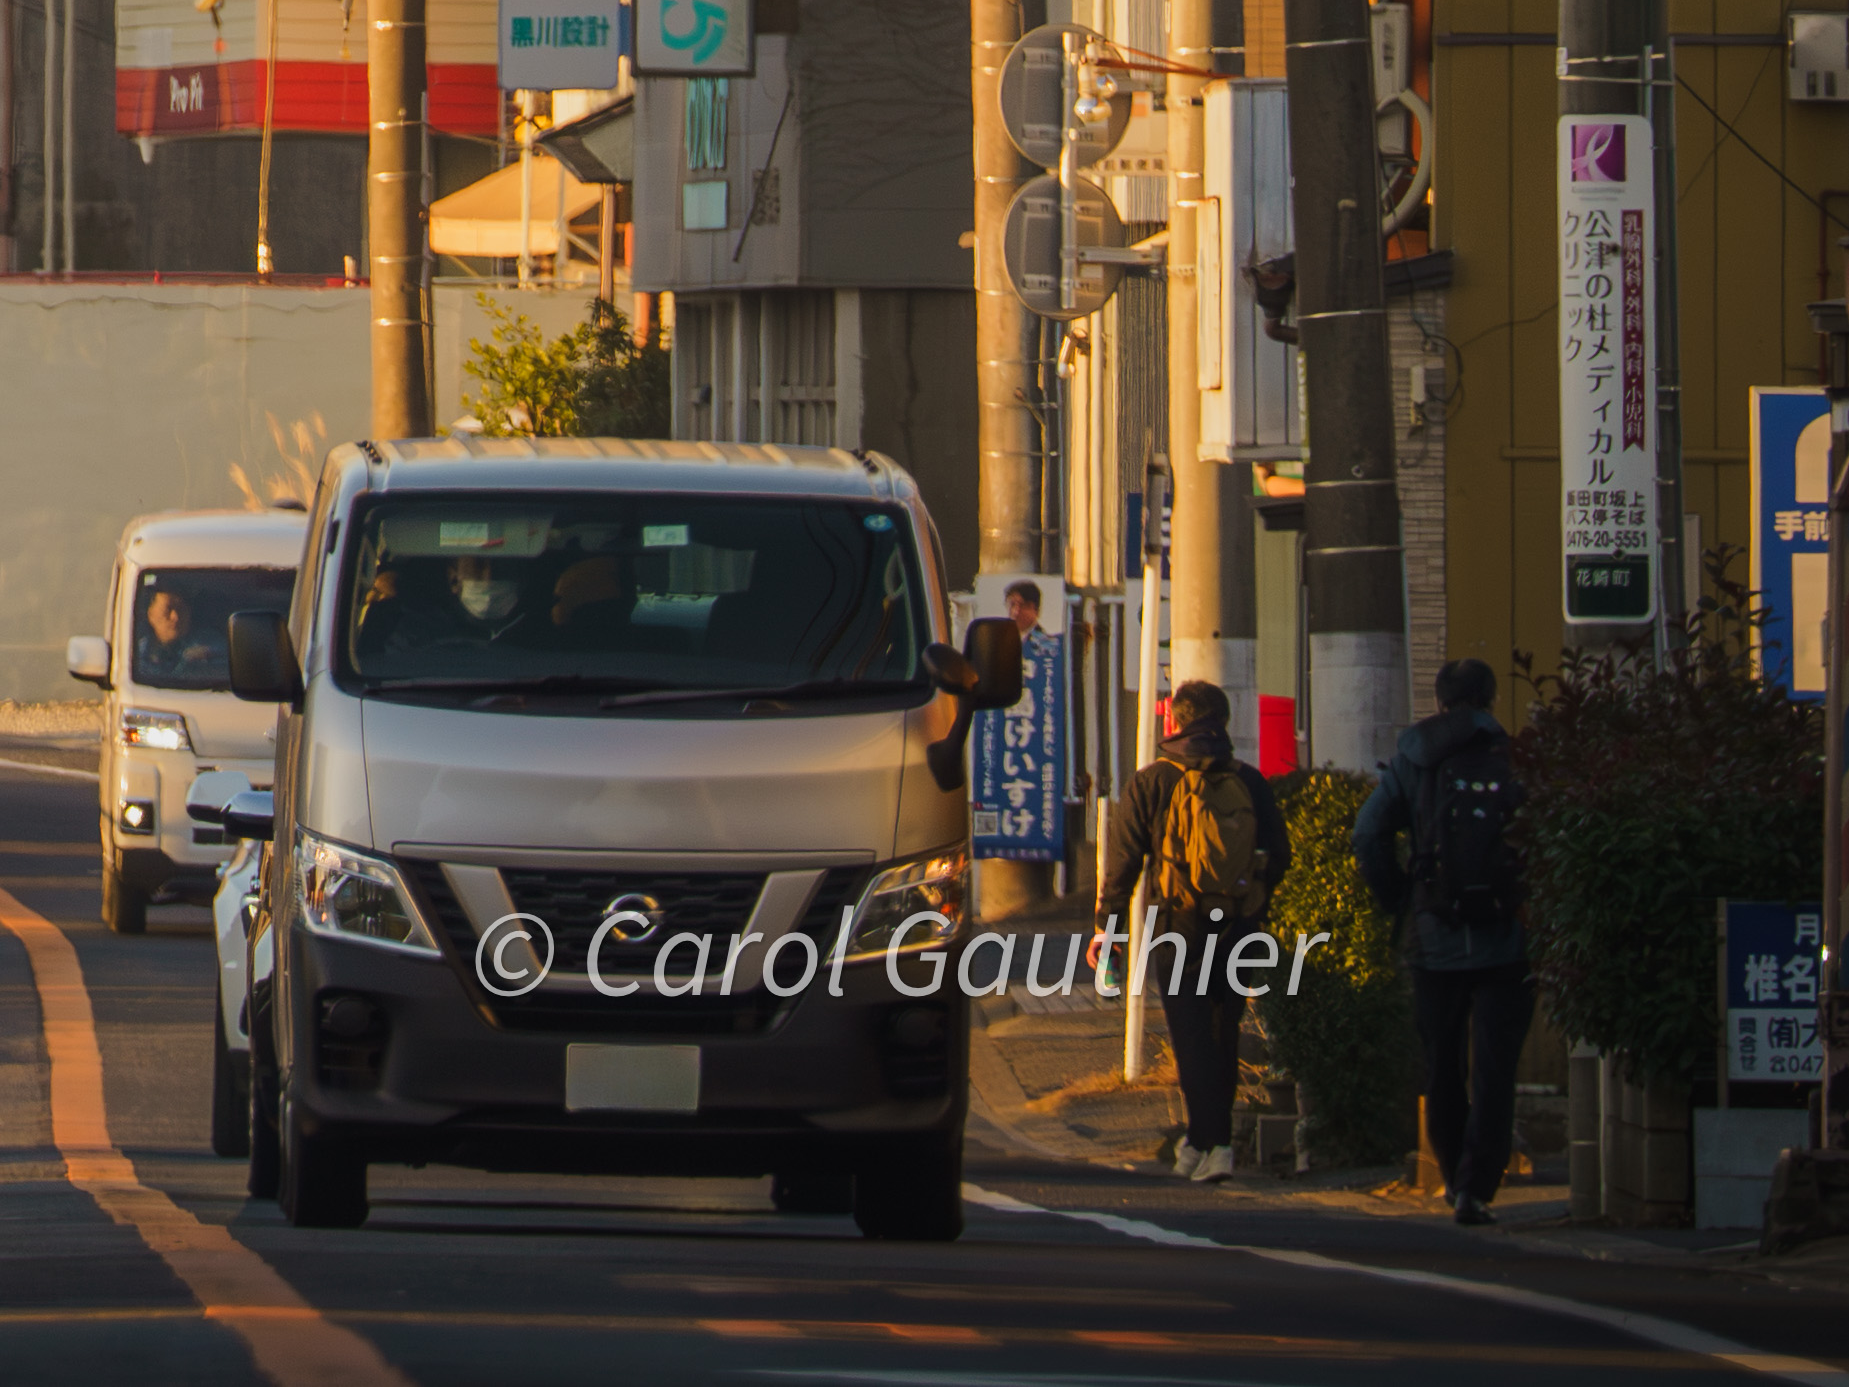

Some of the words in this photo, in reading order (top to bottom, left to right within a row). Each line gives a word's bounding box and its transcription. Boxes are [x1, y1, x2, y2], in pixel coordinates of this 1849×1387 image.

[1564, 210, 1583, 363] クリニック
[1584, 210, 1615, 485] 公津の杜メディカル
[1773, 511, 1828, 541] 手前
[1744, 954, 1816, 1002] 椎名
